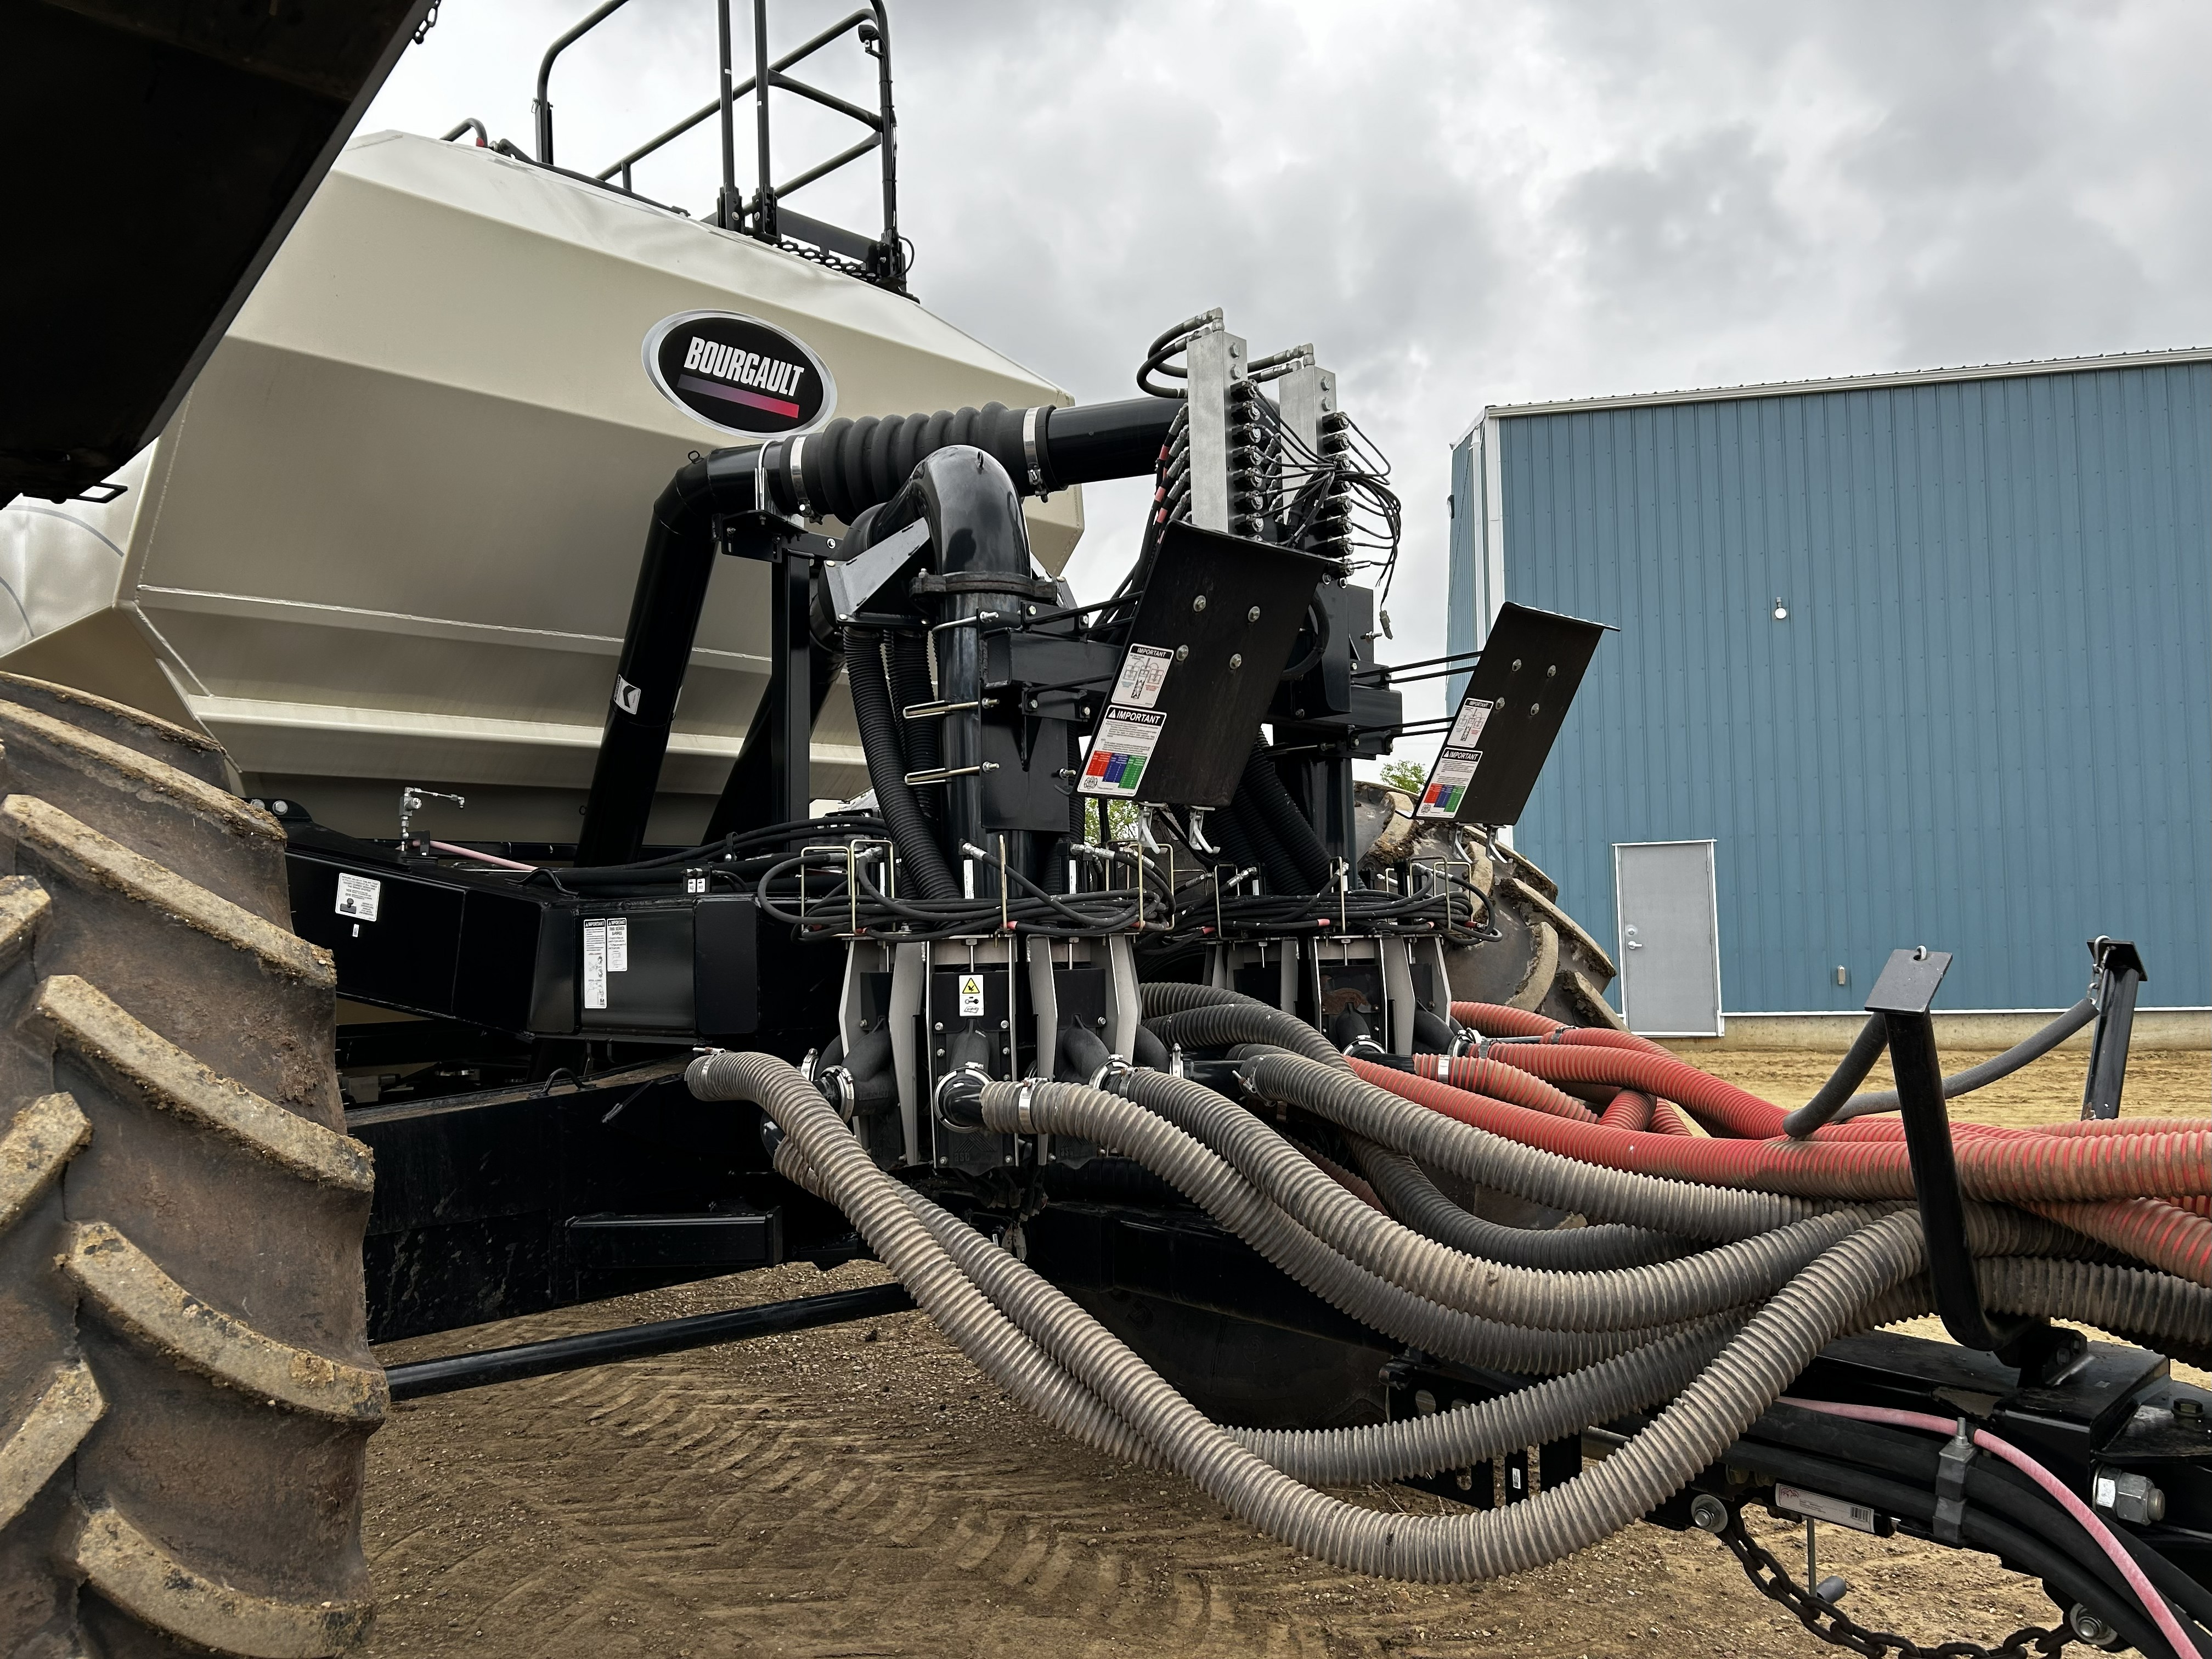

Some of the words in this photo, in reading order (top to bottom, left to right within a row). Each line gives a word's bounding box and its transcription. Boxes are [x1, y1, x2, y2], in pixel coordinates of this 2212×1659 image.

[684, 336, 805, 397] BOURGAULT
[1137, 647, 1167, 658] IMPORTANT
[1116, 710, 1160, 724] IMPORTANT
[1449, 751, 1479, 760] IMPORTANT
[954, 1152, 970, 1162] asc
